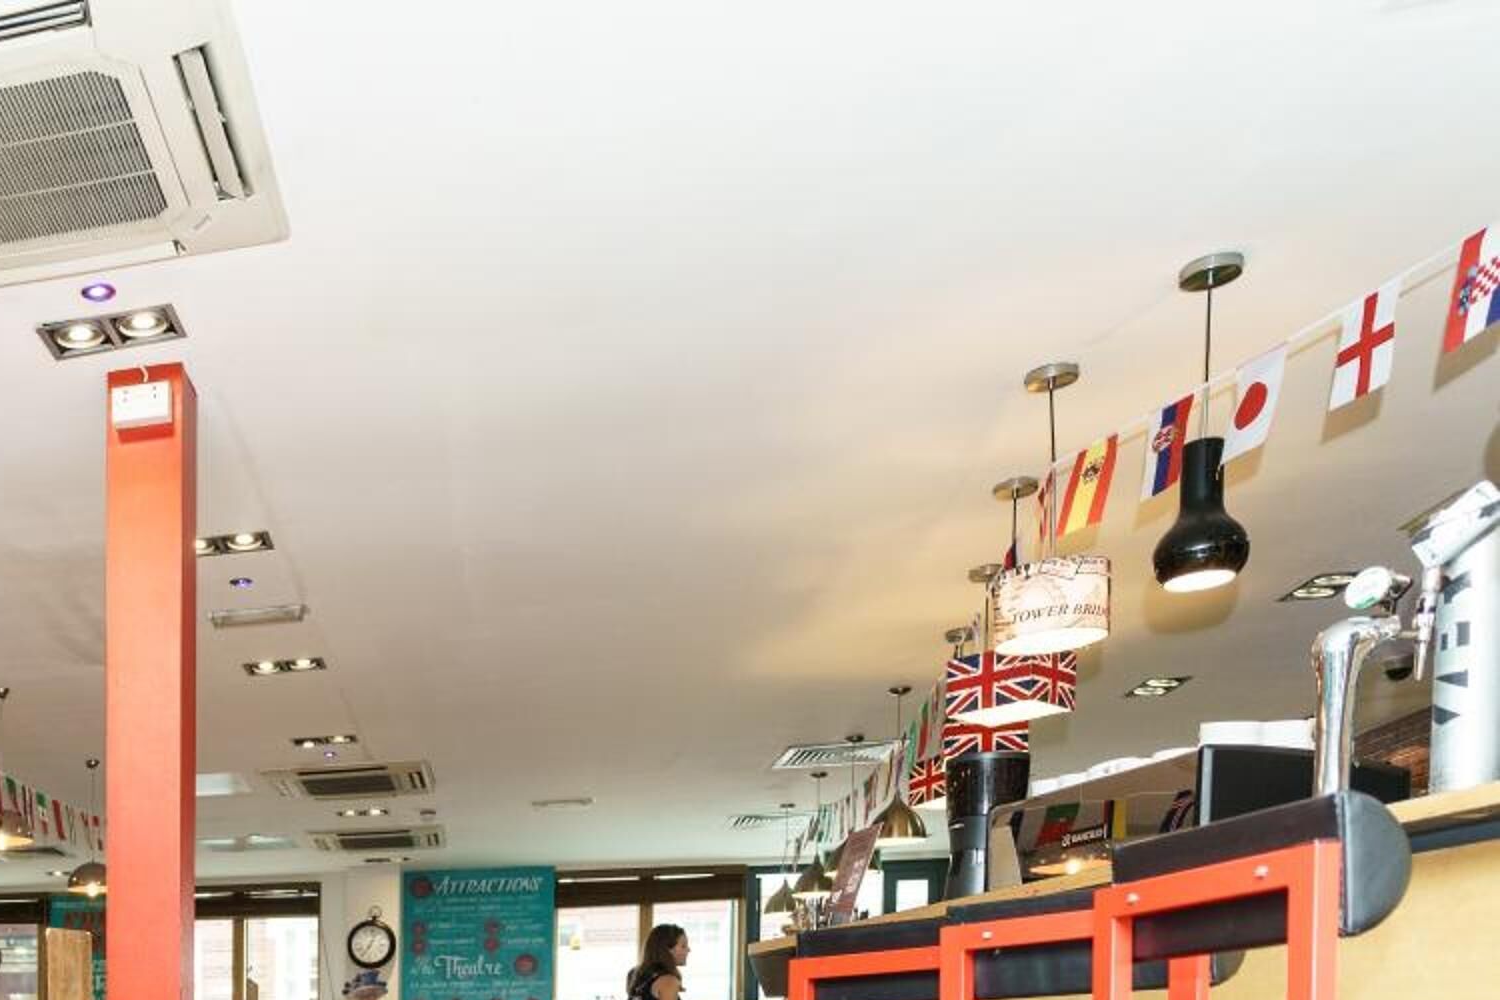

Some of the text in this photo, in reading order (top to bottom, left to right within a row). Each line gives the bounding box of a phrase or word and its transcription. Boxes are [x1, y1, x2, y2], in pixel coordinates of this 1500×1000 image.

[1011, 604, 1069, 625] TOWER
[435, 875, 543, 897] ATTRACTIONS
[433, 954, 503, 979] Theatre
